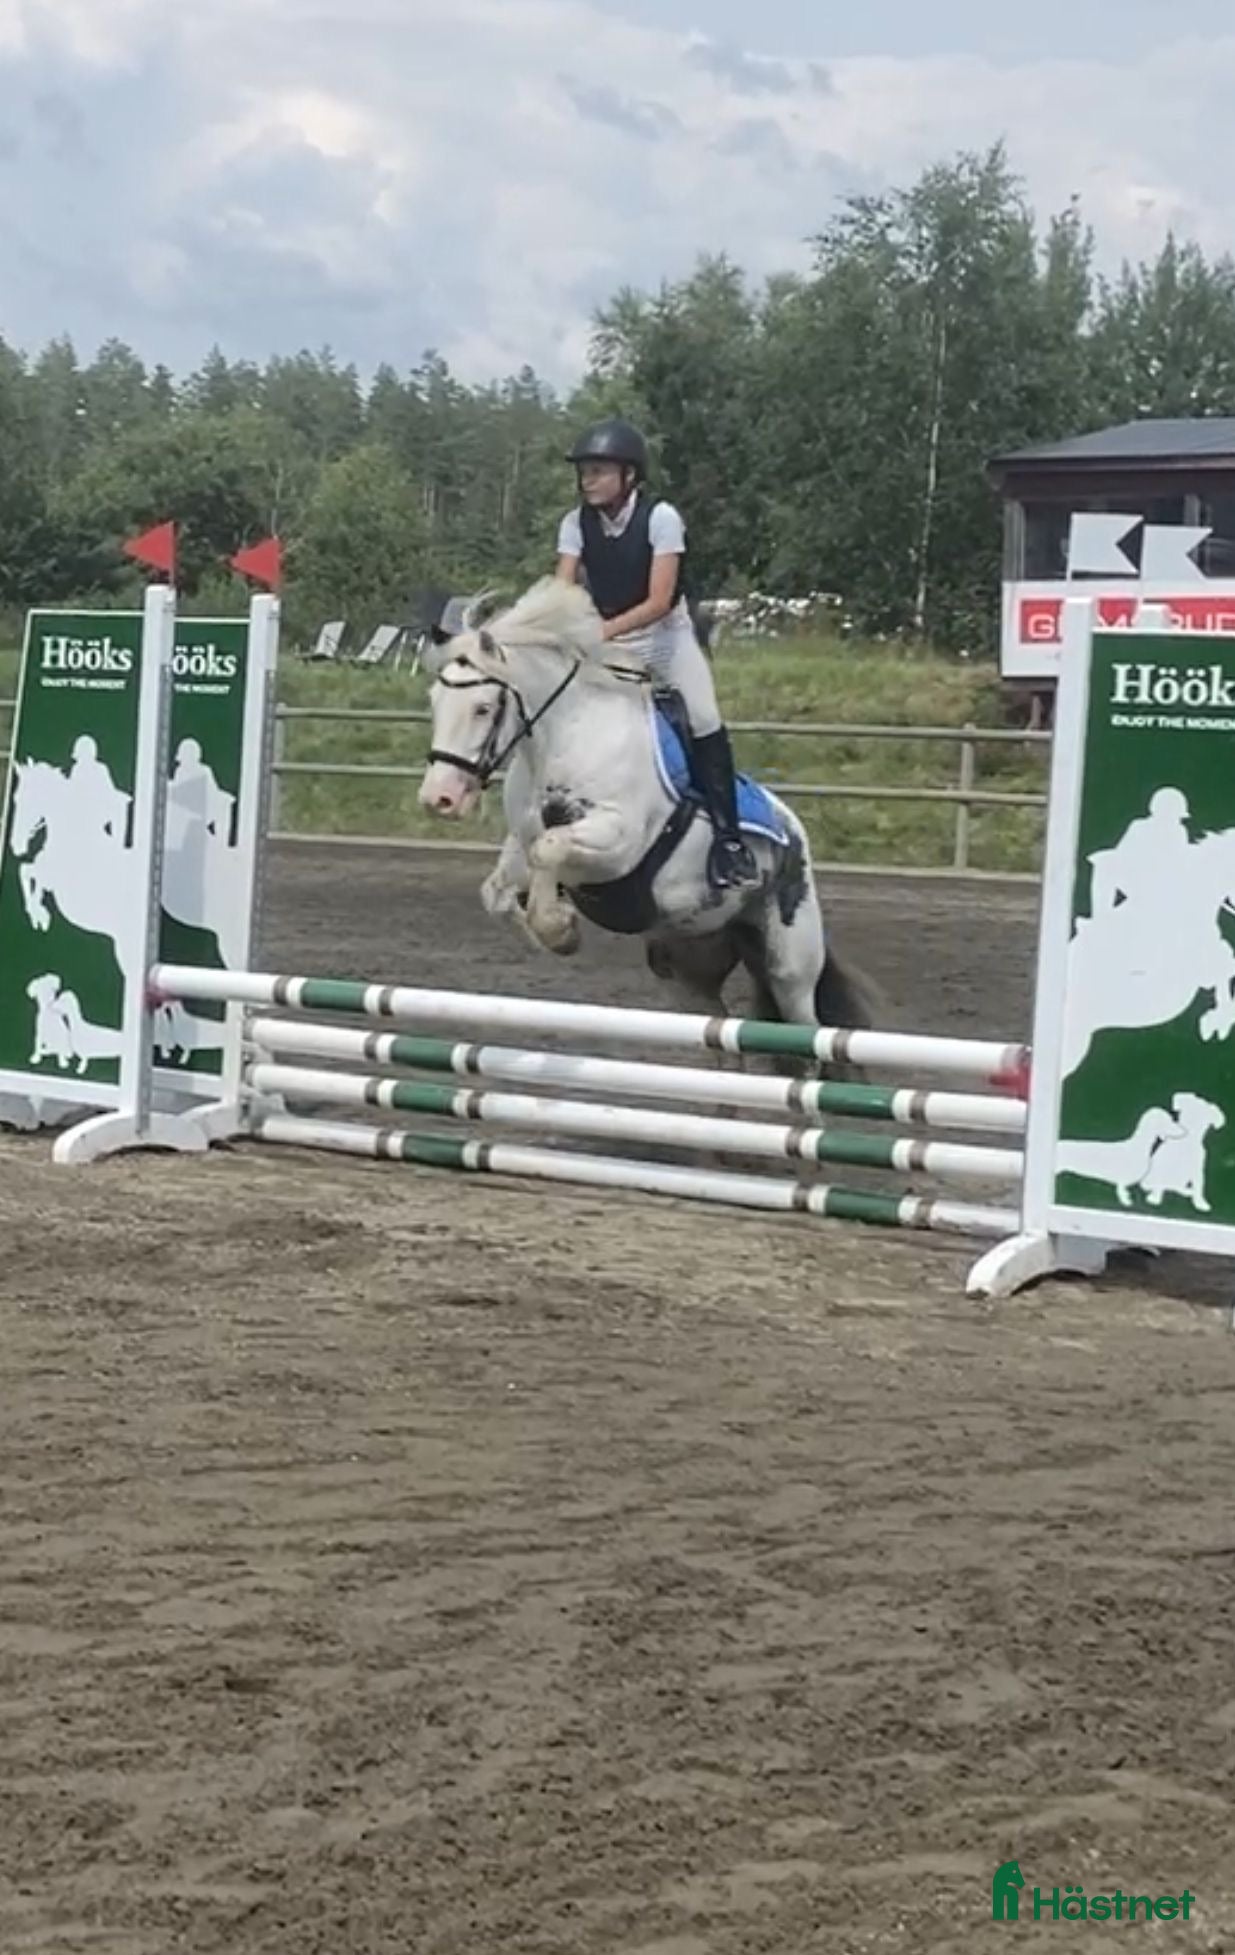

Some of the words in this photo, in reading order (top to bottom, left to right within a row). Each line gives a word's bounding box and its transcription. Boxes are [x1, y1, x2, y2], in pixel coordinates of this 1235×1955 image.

[41, 636, 133, 671] Hööks
[173, 644, 237, 677] ööks
[1111, 664, 1235, 706] Höök
[1157, 716, 1184, 729] THE
[1186, 717, 1235, 731] MOMEN
